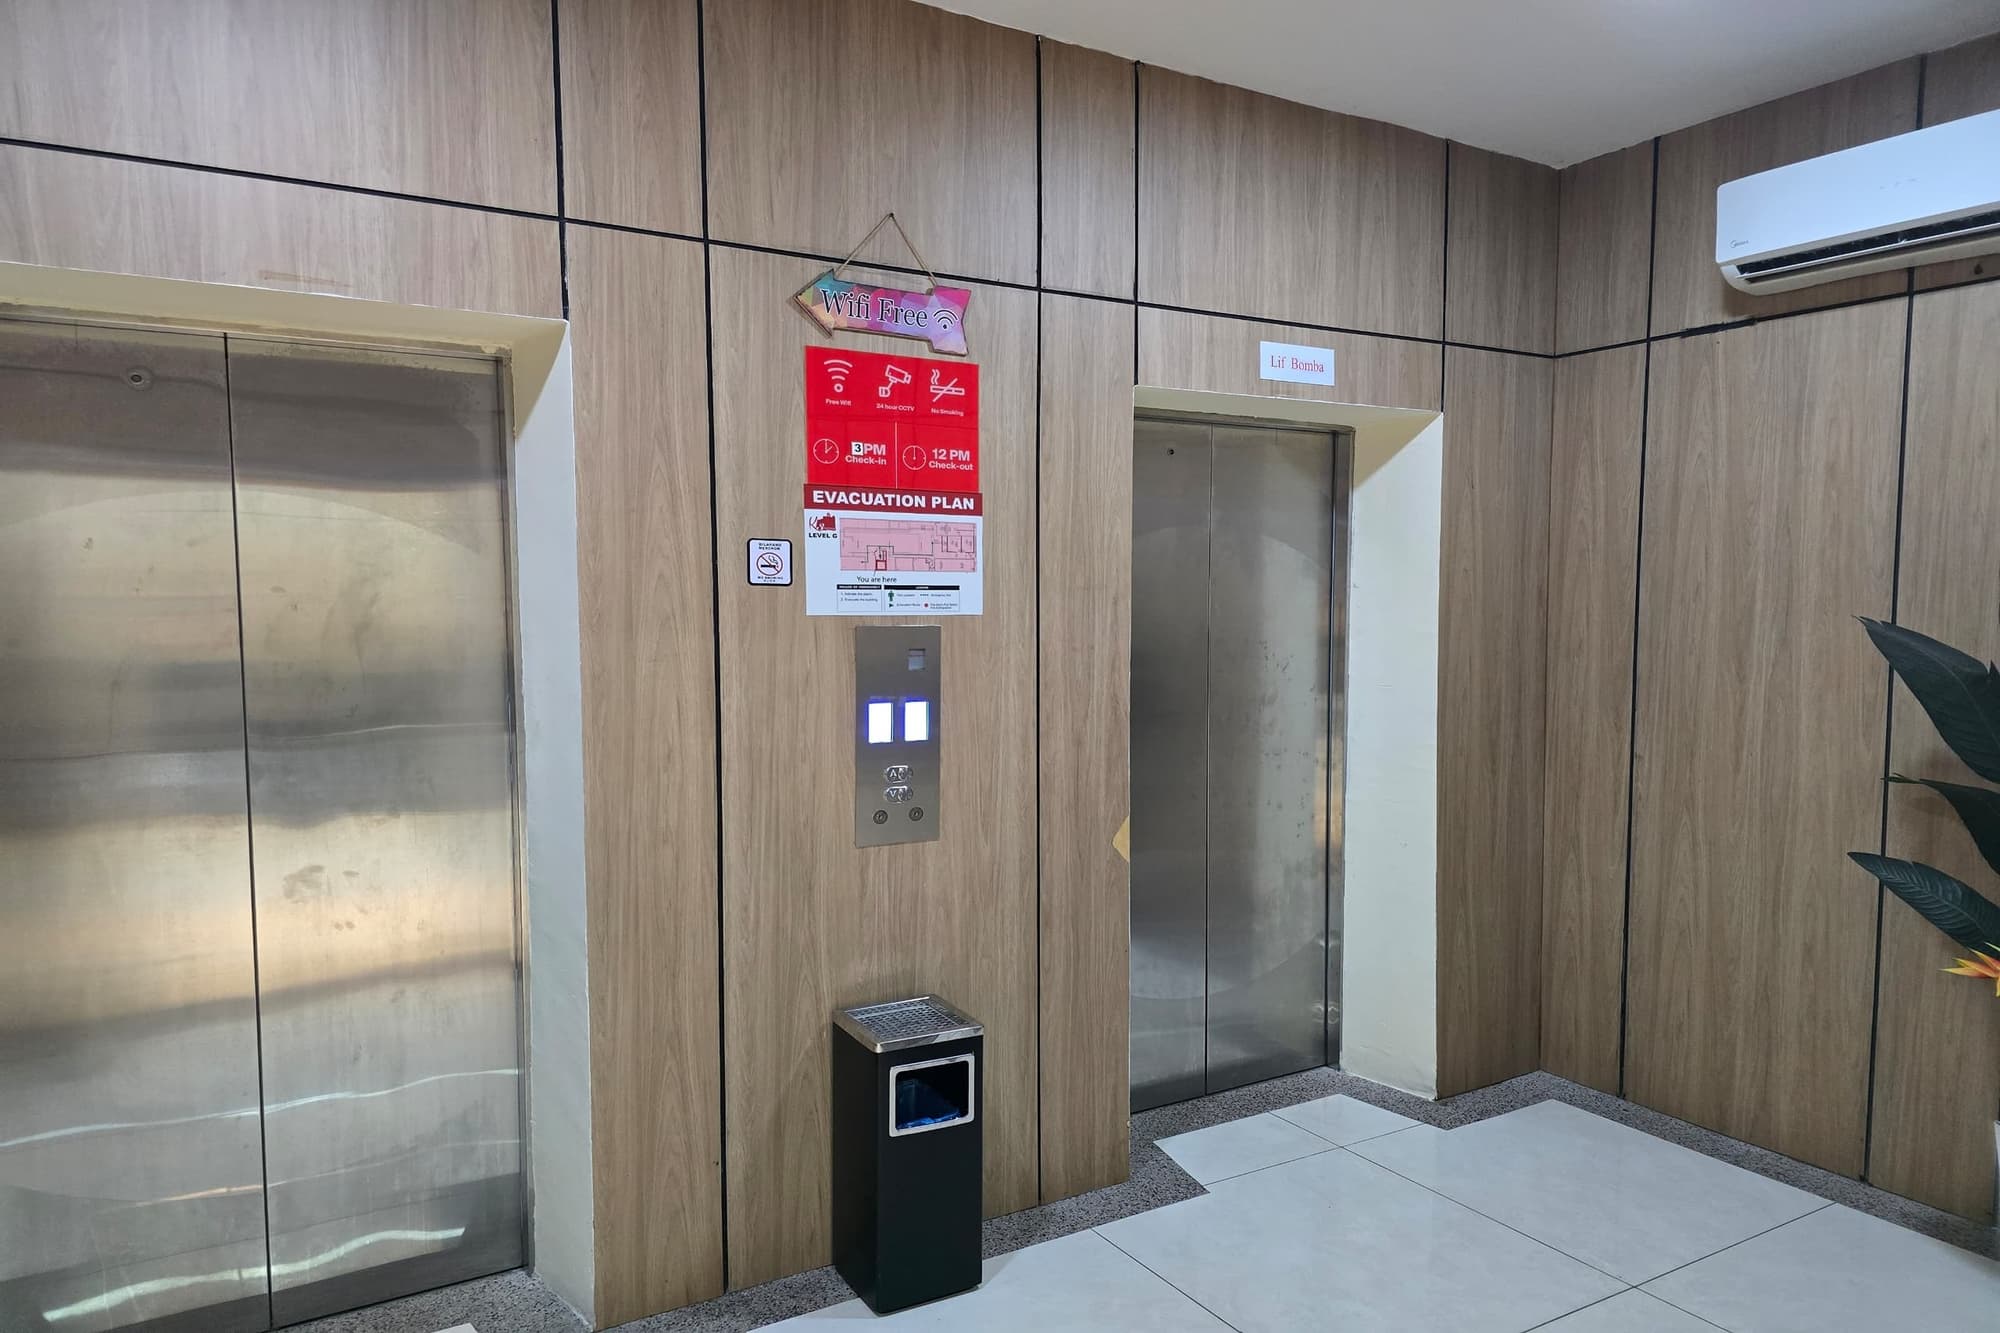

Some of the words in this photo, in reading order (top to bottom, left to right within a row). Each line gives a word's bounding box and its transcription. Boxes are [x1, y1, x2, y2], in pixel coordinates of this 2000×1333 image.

[821, 289, 870, 320] Wifi
[878, 298, 928, 327] Free
[1271, 355, 1286, 368] Lif
[1291, 357, 1324, 372] Bomba
[940, 408, 964, 416] Smoking
[845, 455, 887, 465] Check-in
[932, 449, 946, 460] 12
[950, 450, 970, 461] PM
[928, 461, 974, 471] Check-out
[812, 490, 926, 508] EVACUATION
[931, 496, 975, 510] PLAN
